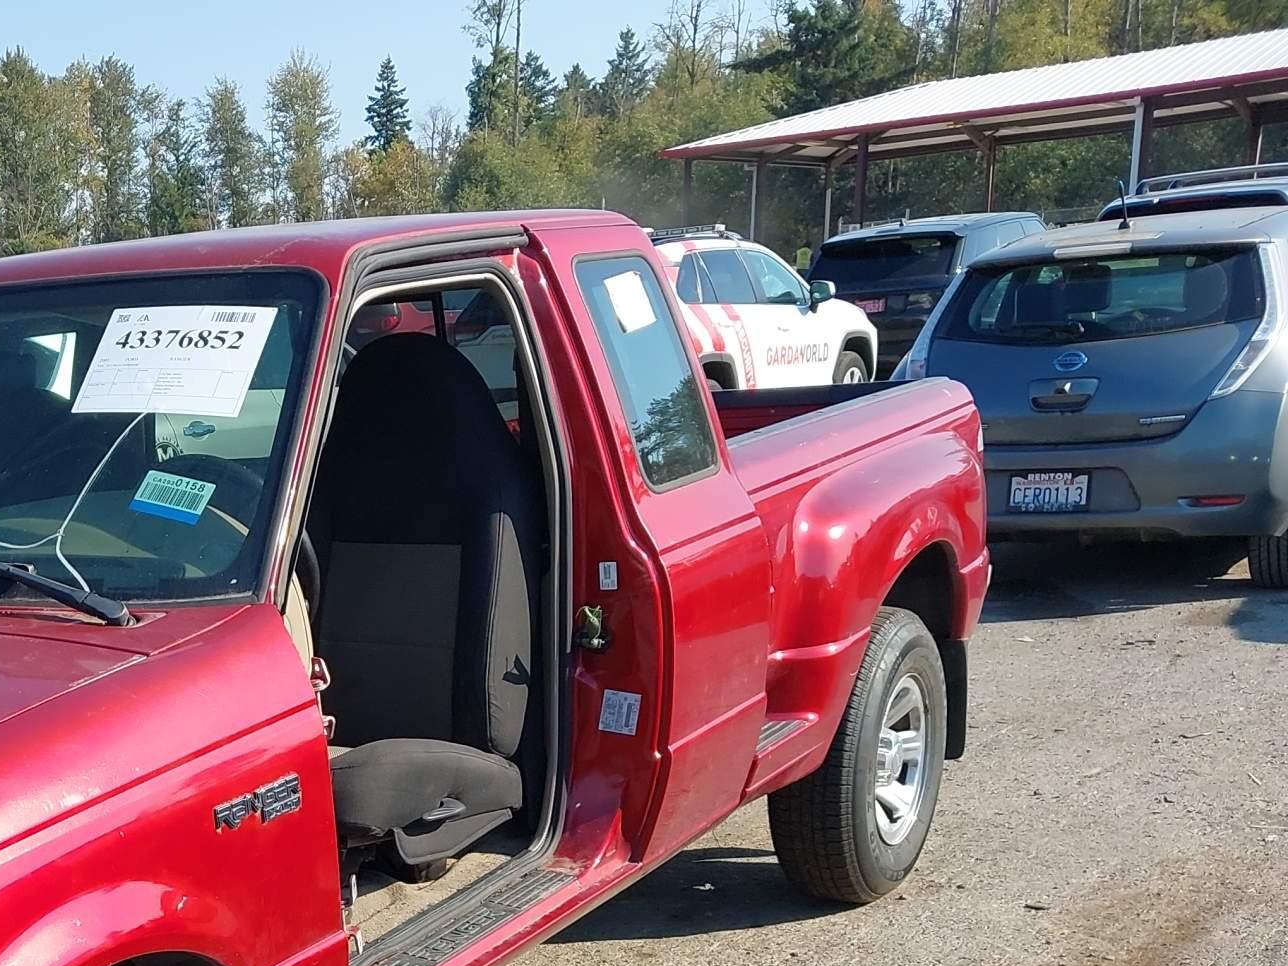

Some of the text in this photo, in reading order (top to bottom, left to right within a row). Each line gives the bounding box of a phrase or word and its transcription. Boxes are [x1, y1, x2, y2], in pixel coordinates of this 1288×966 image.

[115, 329, 244, 349] 43376852
[1027, 472, 1072, 480] RENTON
[213, 773, 300, 831] RANGER
